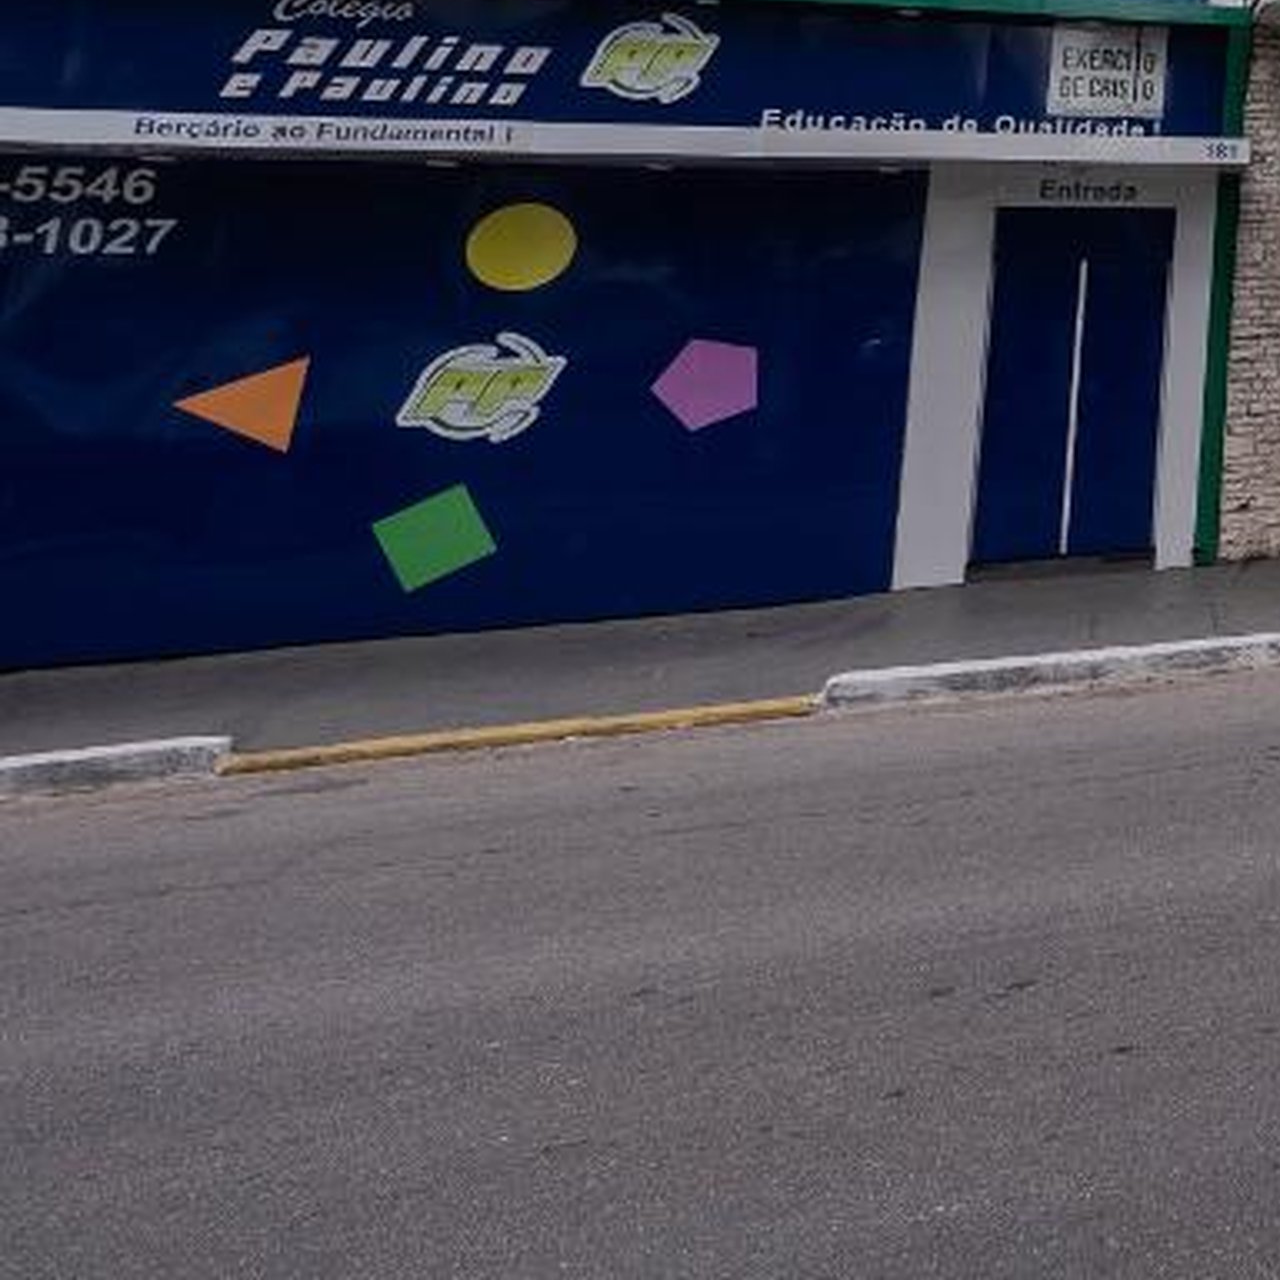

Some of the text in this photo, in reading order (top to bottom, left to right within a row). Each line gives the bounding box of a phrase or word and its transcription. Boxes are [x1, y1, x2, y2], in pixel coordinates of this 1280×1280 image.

[230, 28, 552, 75] Paulino
[219, 70, 527, 106] e Paulino
[271, 124, 306, 138] ao
[316, 121, 496, 142] Fundamental
[943, 115, 978, 134] de
[1038, 178, 1138, 202] Entrada
